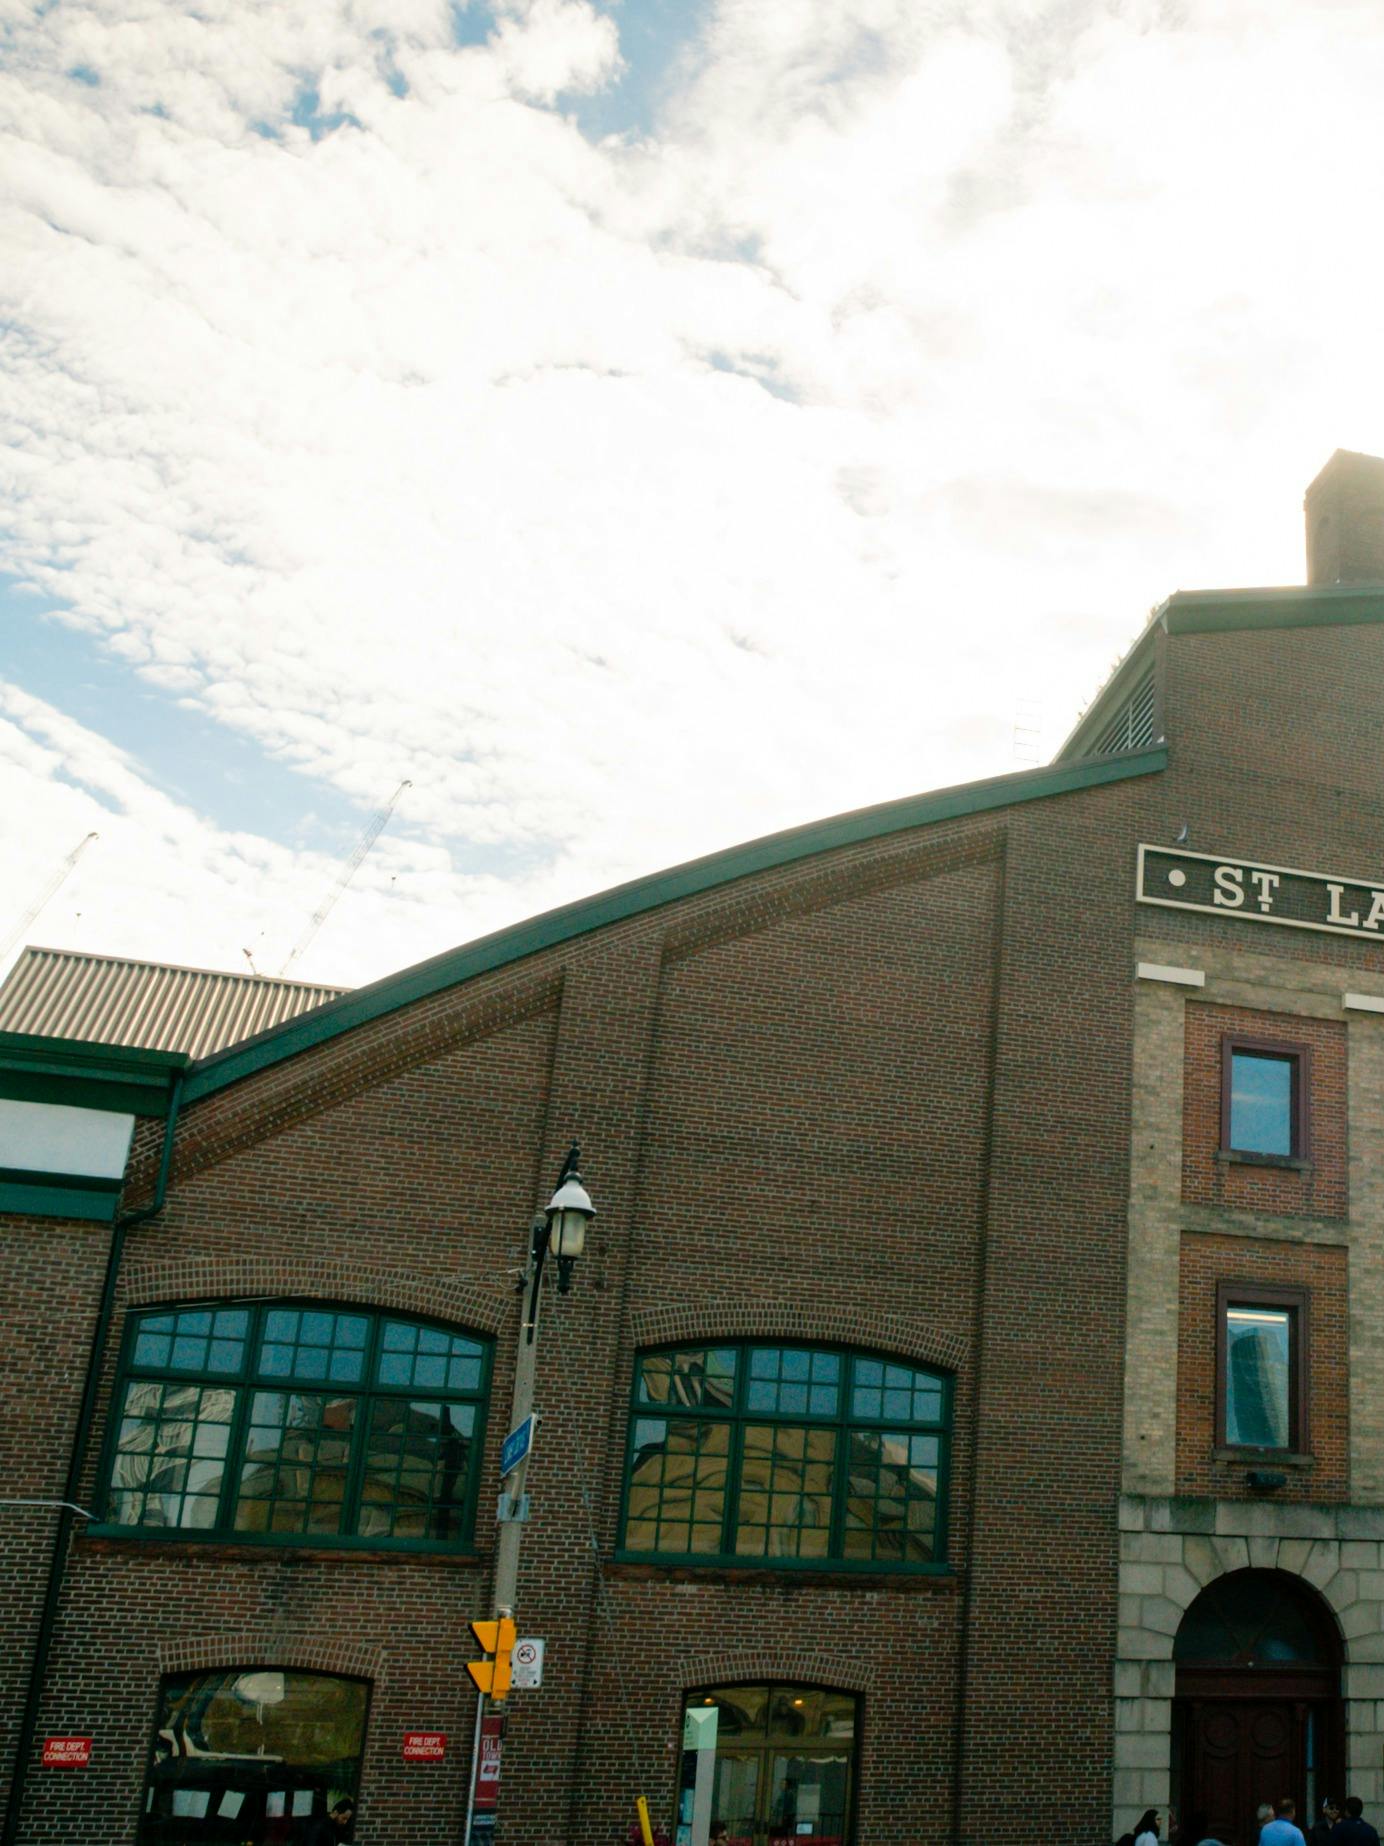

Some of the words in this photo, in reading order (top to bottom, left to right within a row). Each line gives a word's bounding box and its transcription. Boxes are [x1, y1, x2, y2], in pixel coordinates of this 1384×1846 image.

[49, 1741, 66, 1751] FIRE
[409, 1737, 424, 1746] FIRE
[482, 1739, 503, 1751] OLD
[403, 1746, 445, 1756] CONNECTION
[43, 1751, 89, 1762] CONNECTION
